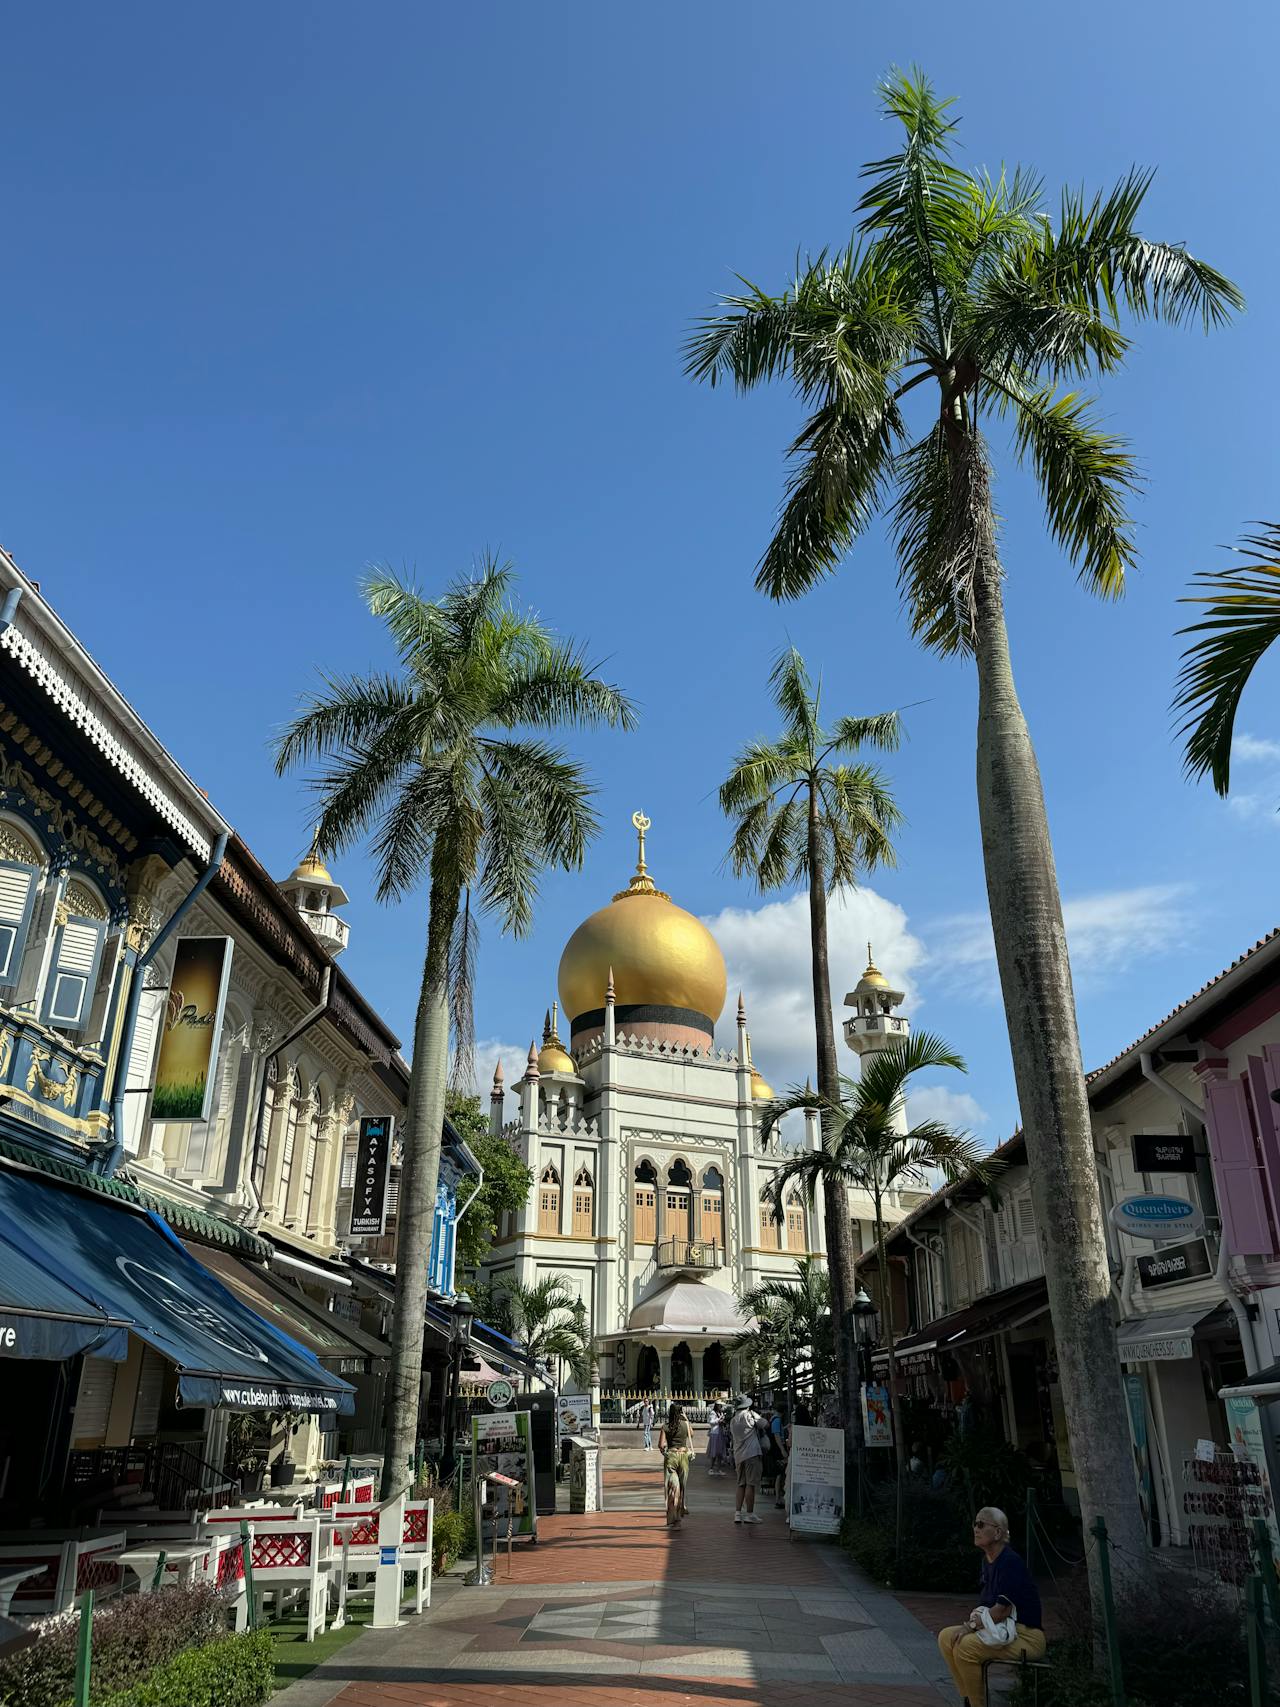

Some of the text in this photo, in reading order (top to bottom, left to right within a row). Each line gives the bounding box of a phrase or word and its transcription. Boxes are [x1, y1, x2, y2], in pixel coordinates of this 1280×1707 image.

[363, 1138, 378, 1215] AYASOFYA
[1126, 1202, 1190, 1215] Quenchers
[353, 1218, 380, 1226] TURKISH
